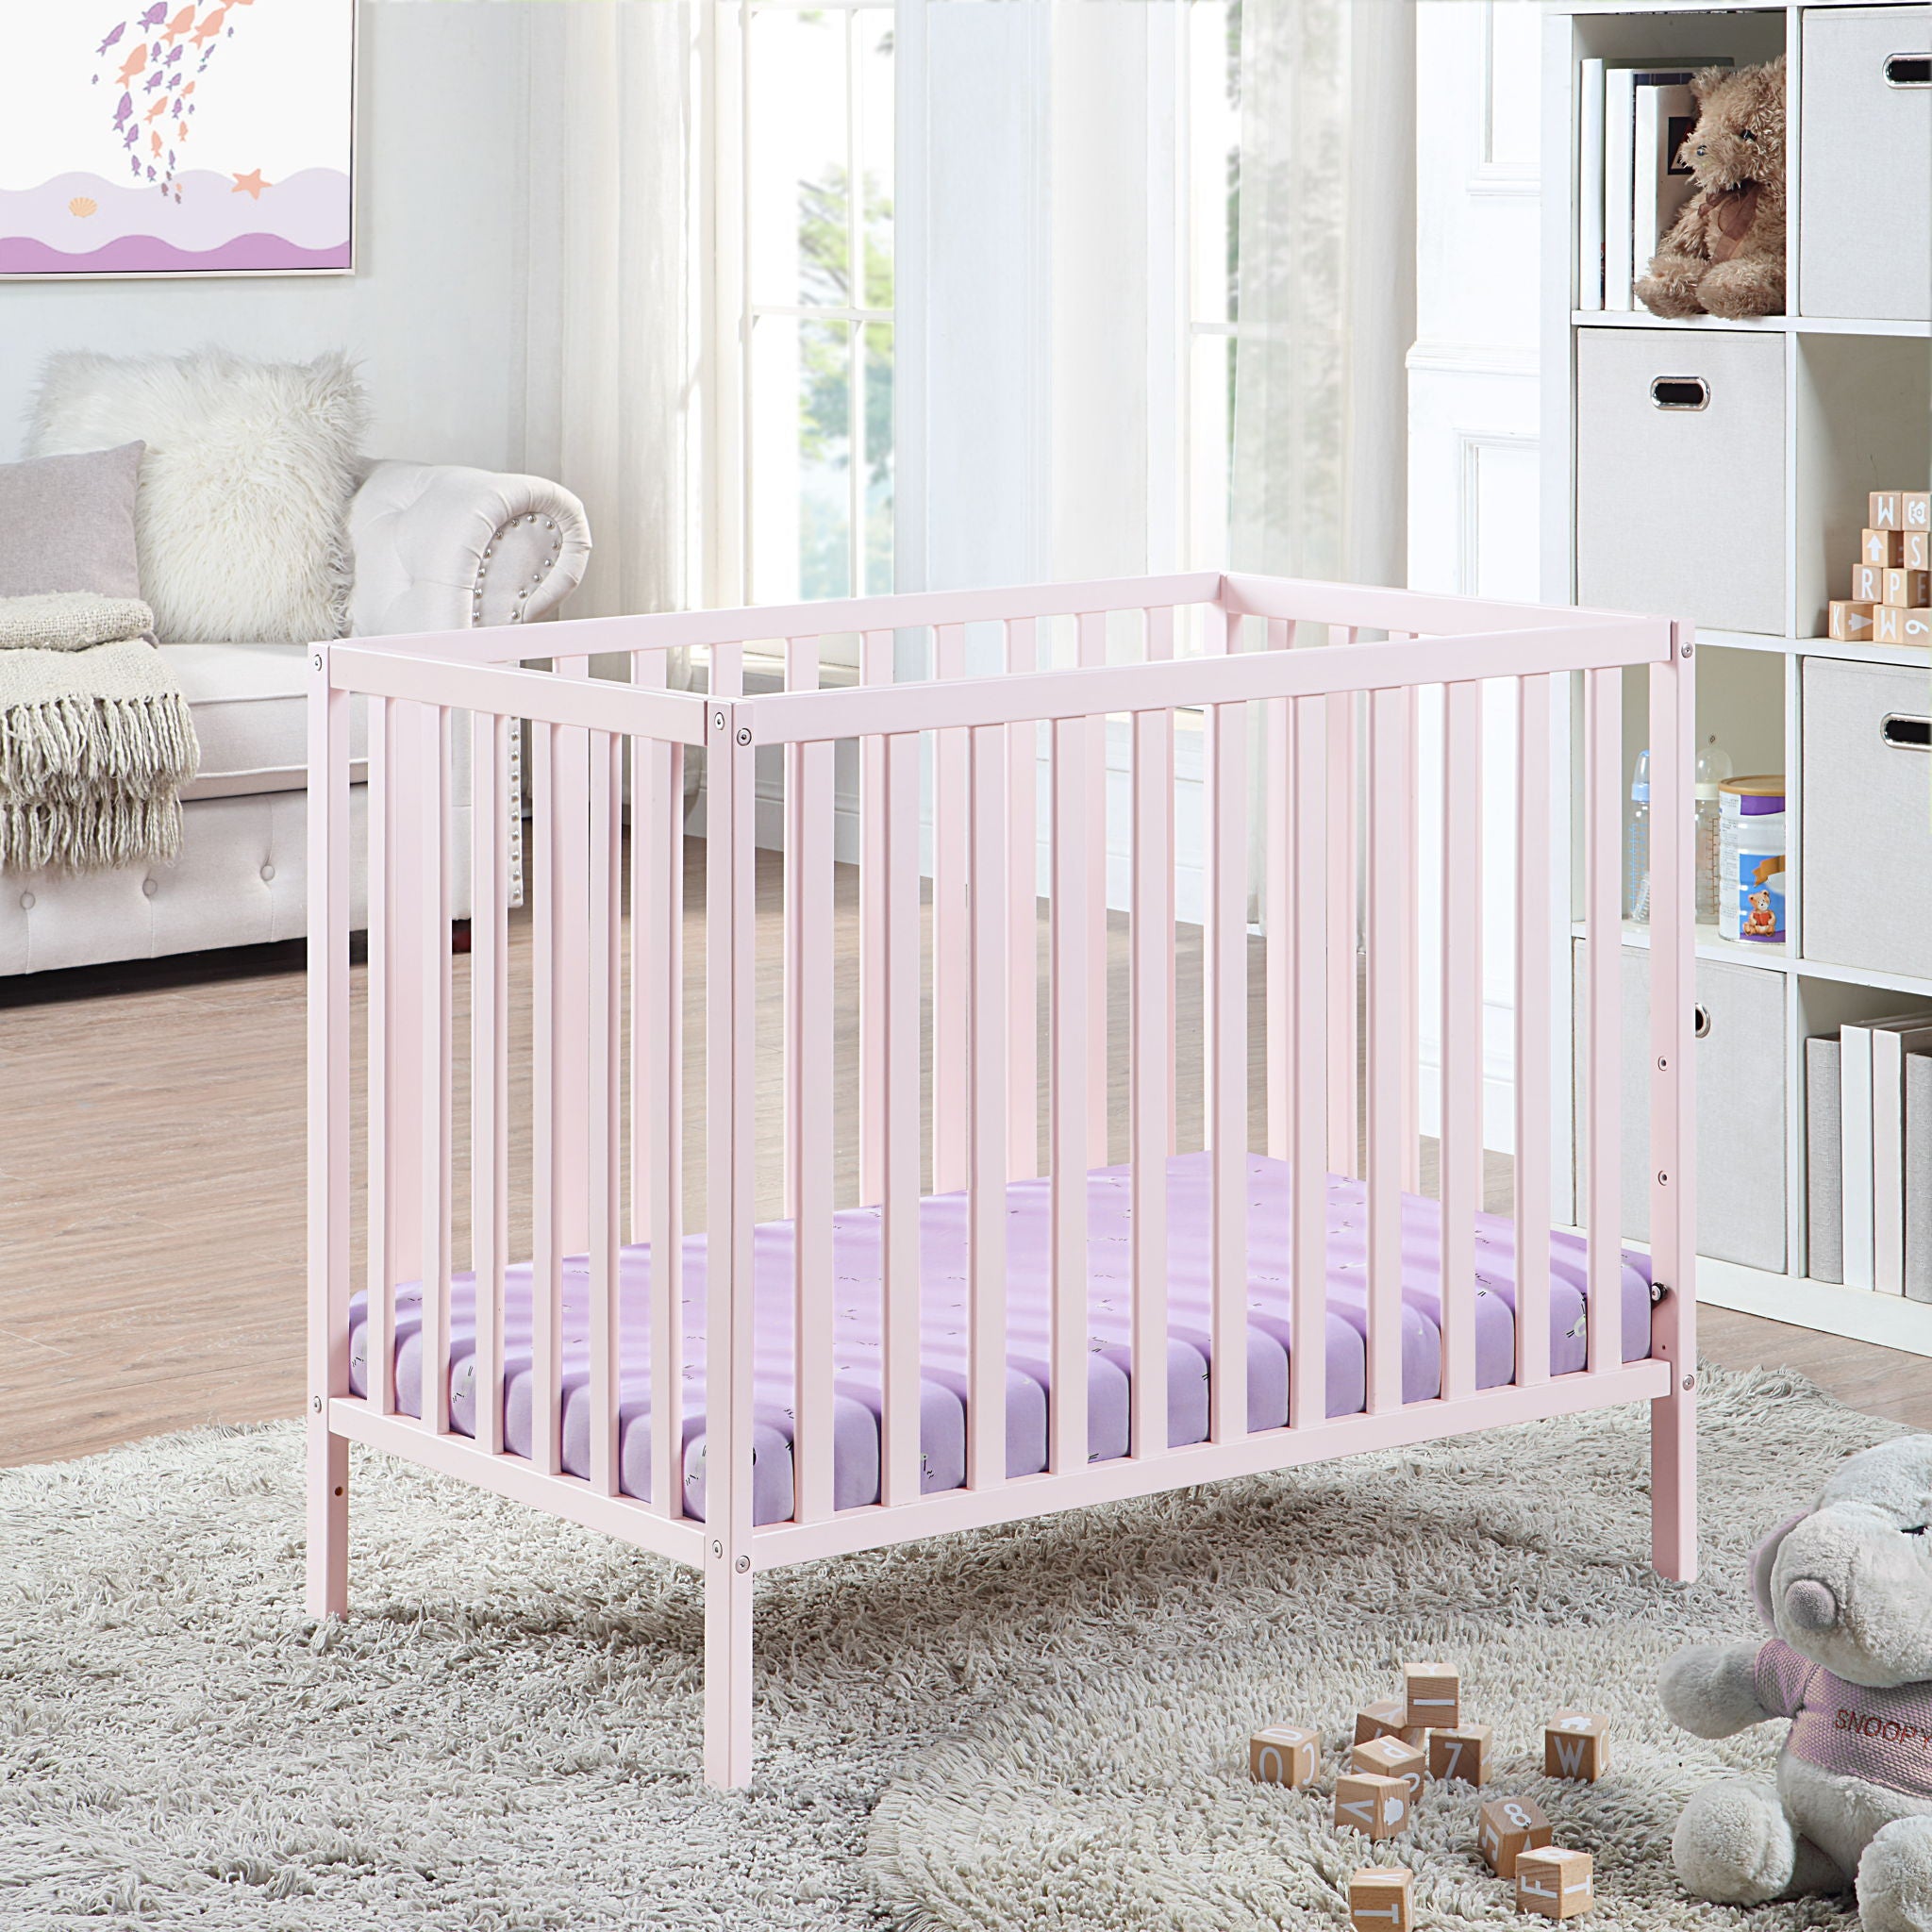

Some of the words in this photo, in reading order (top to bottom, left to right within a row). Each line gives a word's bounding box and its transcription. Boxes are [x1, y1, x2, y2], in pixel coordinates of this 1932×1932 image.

[1861, 568, 1874, 599] R
[1890, 573, 1900, 603] P
[1553, 1736, 1586, 1776] W
[1504, 1803, 1532, 1827] 8
[1521, 1874, 1558, 1900] F
[1354, 1903, 1400, 1924] T
